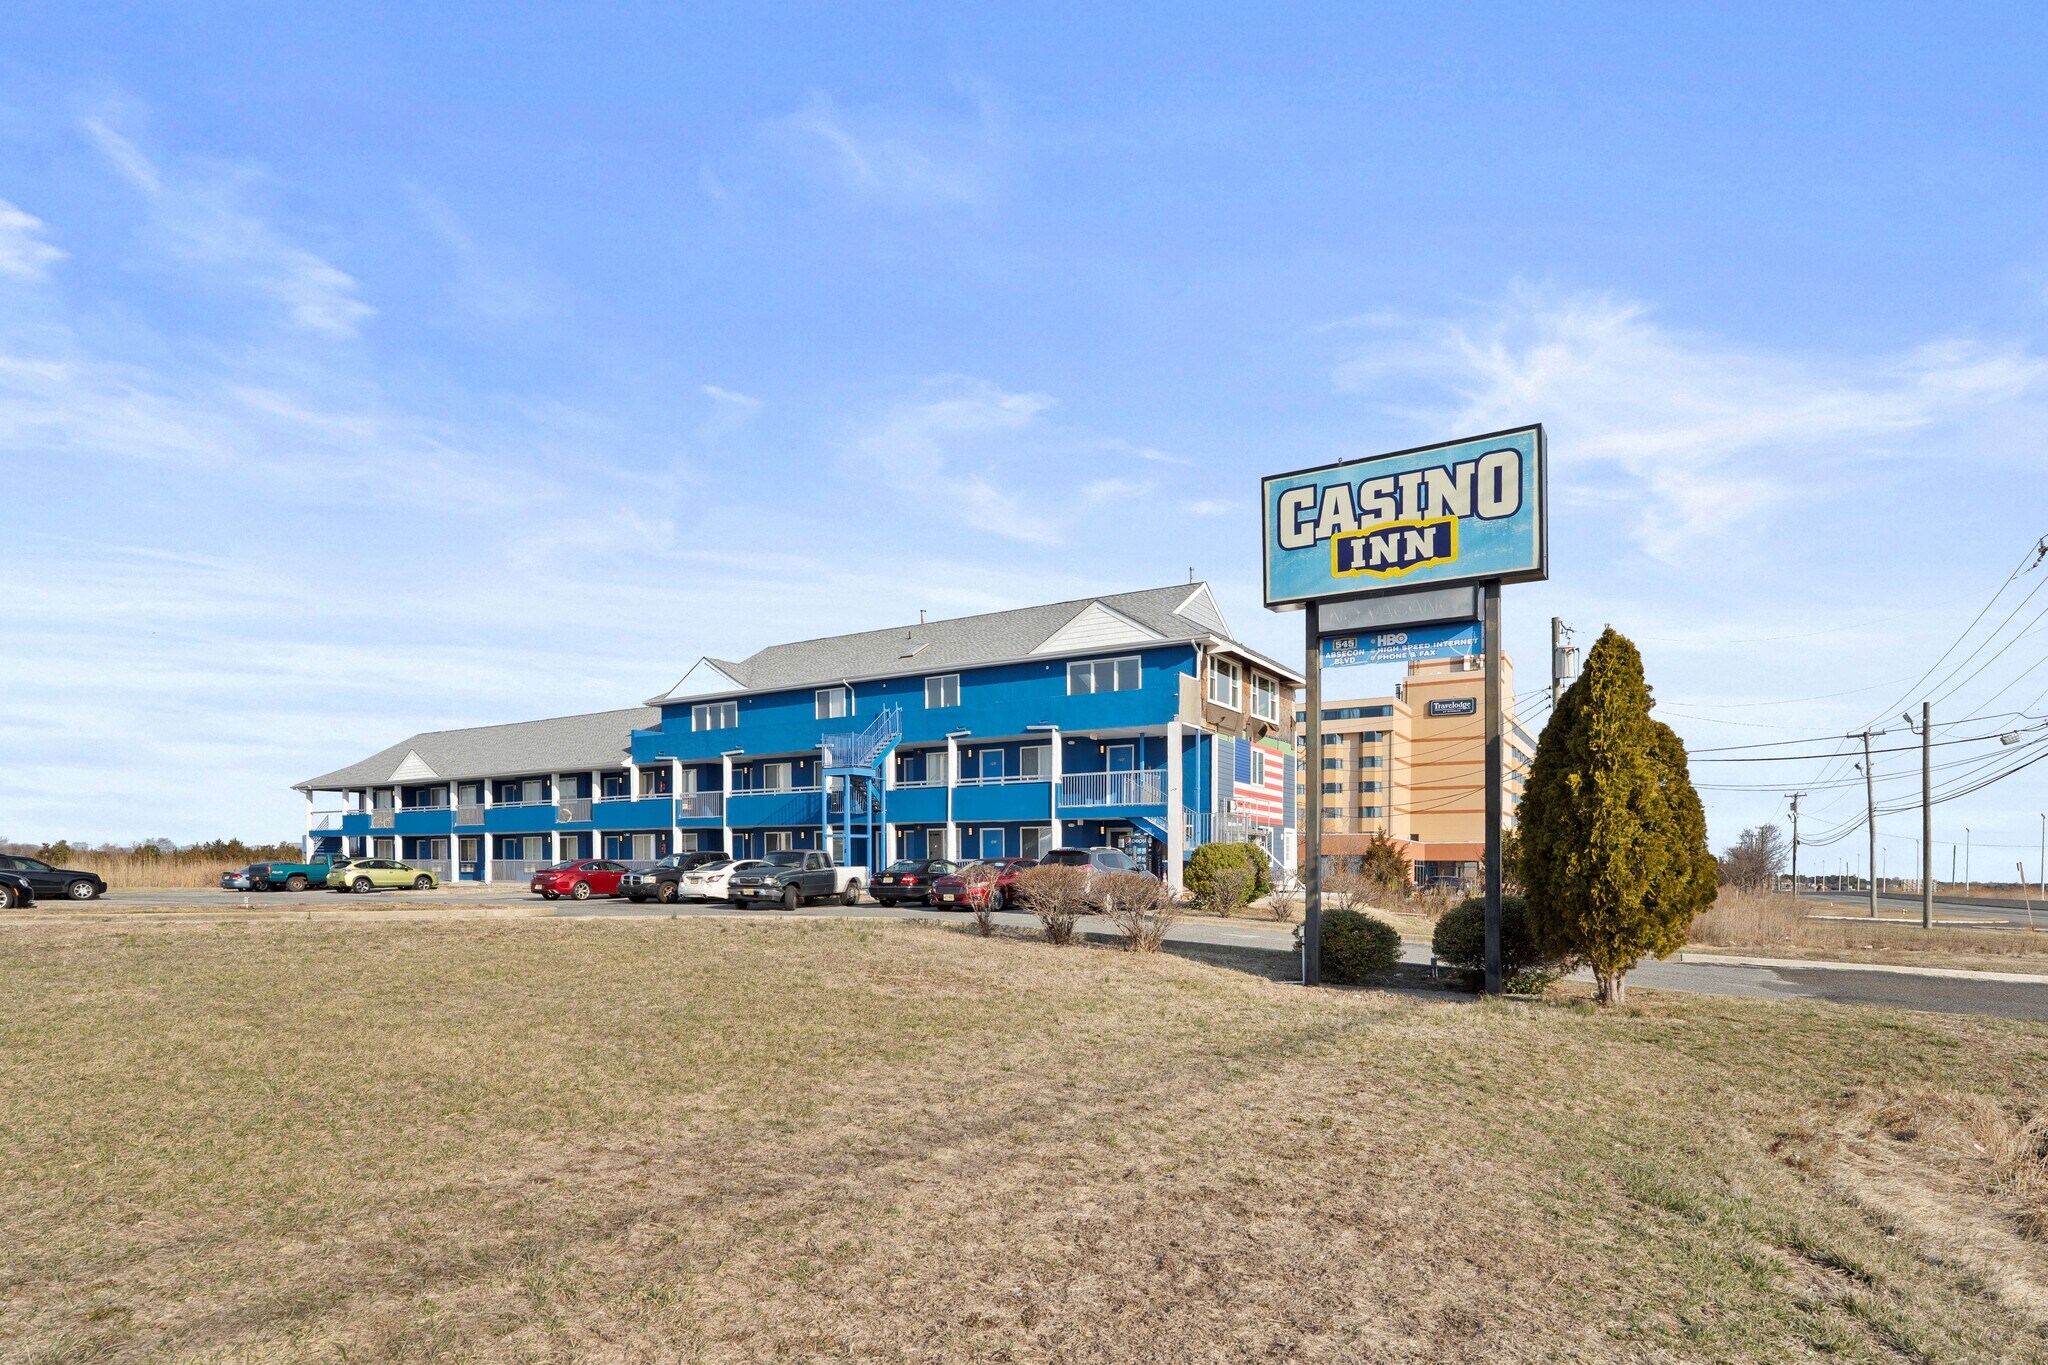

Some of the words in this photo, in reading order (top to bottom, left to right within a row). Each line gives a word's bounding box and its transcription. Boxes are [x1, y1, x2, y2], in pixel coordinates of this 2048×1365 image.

[1278, 449, 1521, 550] CASINO
[1350, 527, 1437, 568] INN
[1335, 640, 1355, 649] 545
[1377, 632, 1408, 647] HBO
[1377, 646, 1399, 654] HIGH
[1402, 642, 1430, 651] SPEED
[1433, 638, 1479, 648] INTERNET
[1325, 649, 1365, 659] ABSECON
[1377, 652, 1407, 661] PHONE
[1419, 649, 1436, 657] FAX
[1334, 657, 1356, 665] BLVD
[1433, 701, 1471, 710] Travelodge
